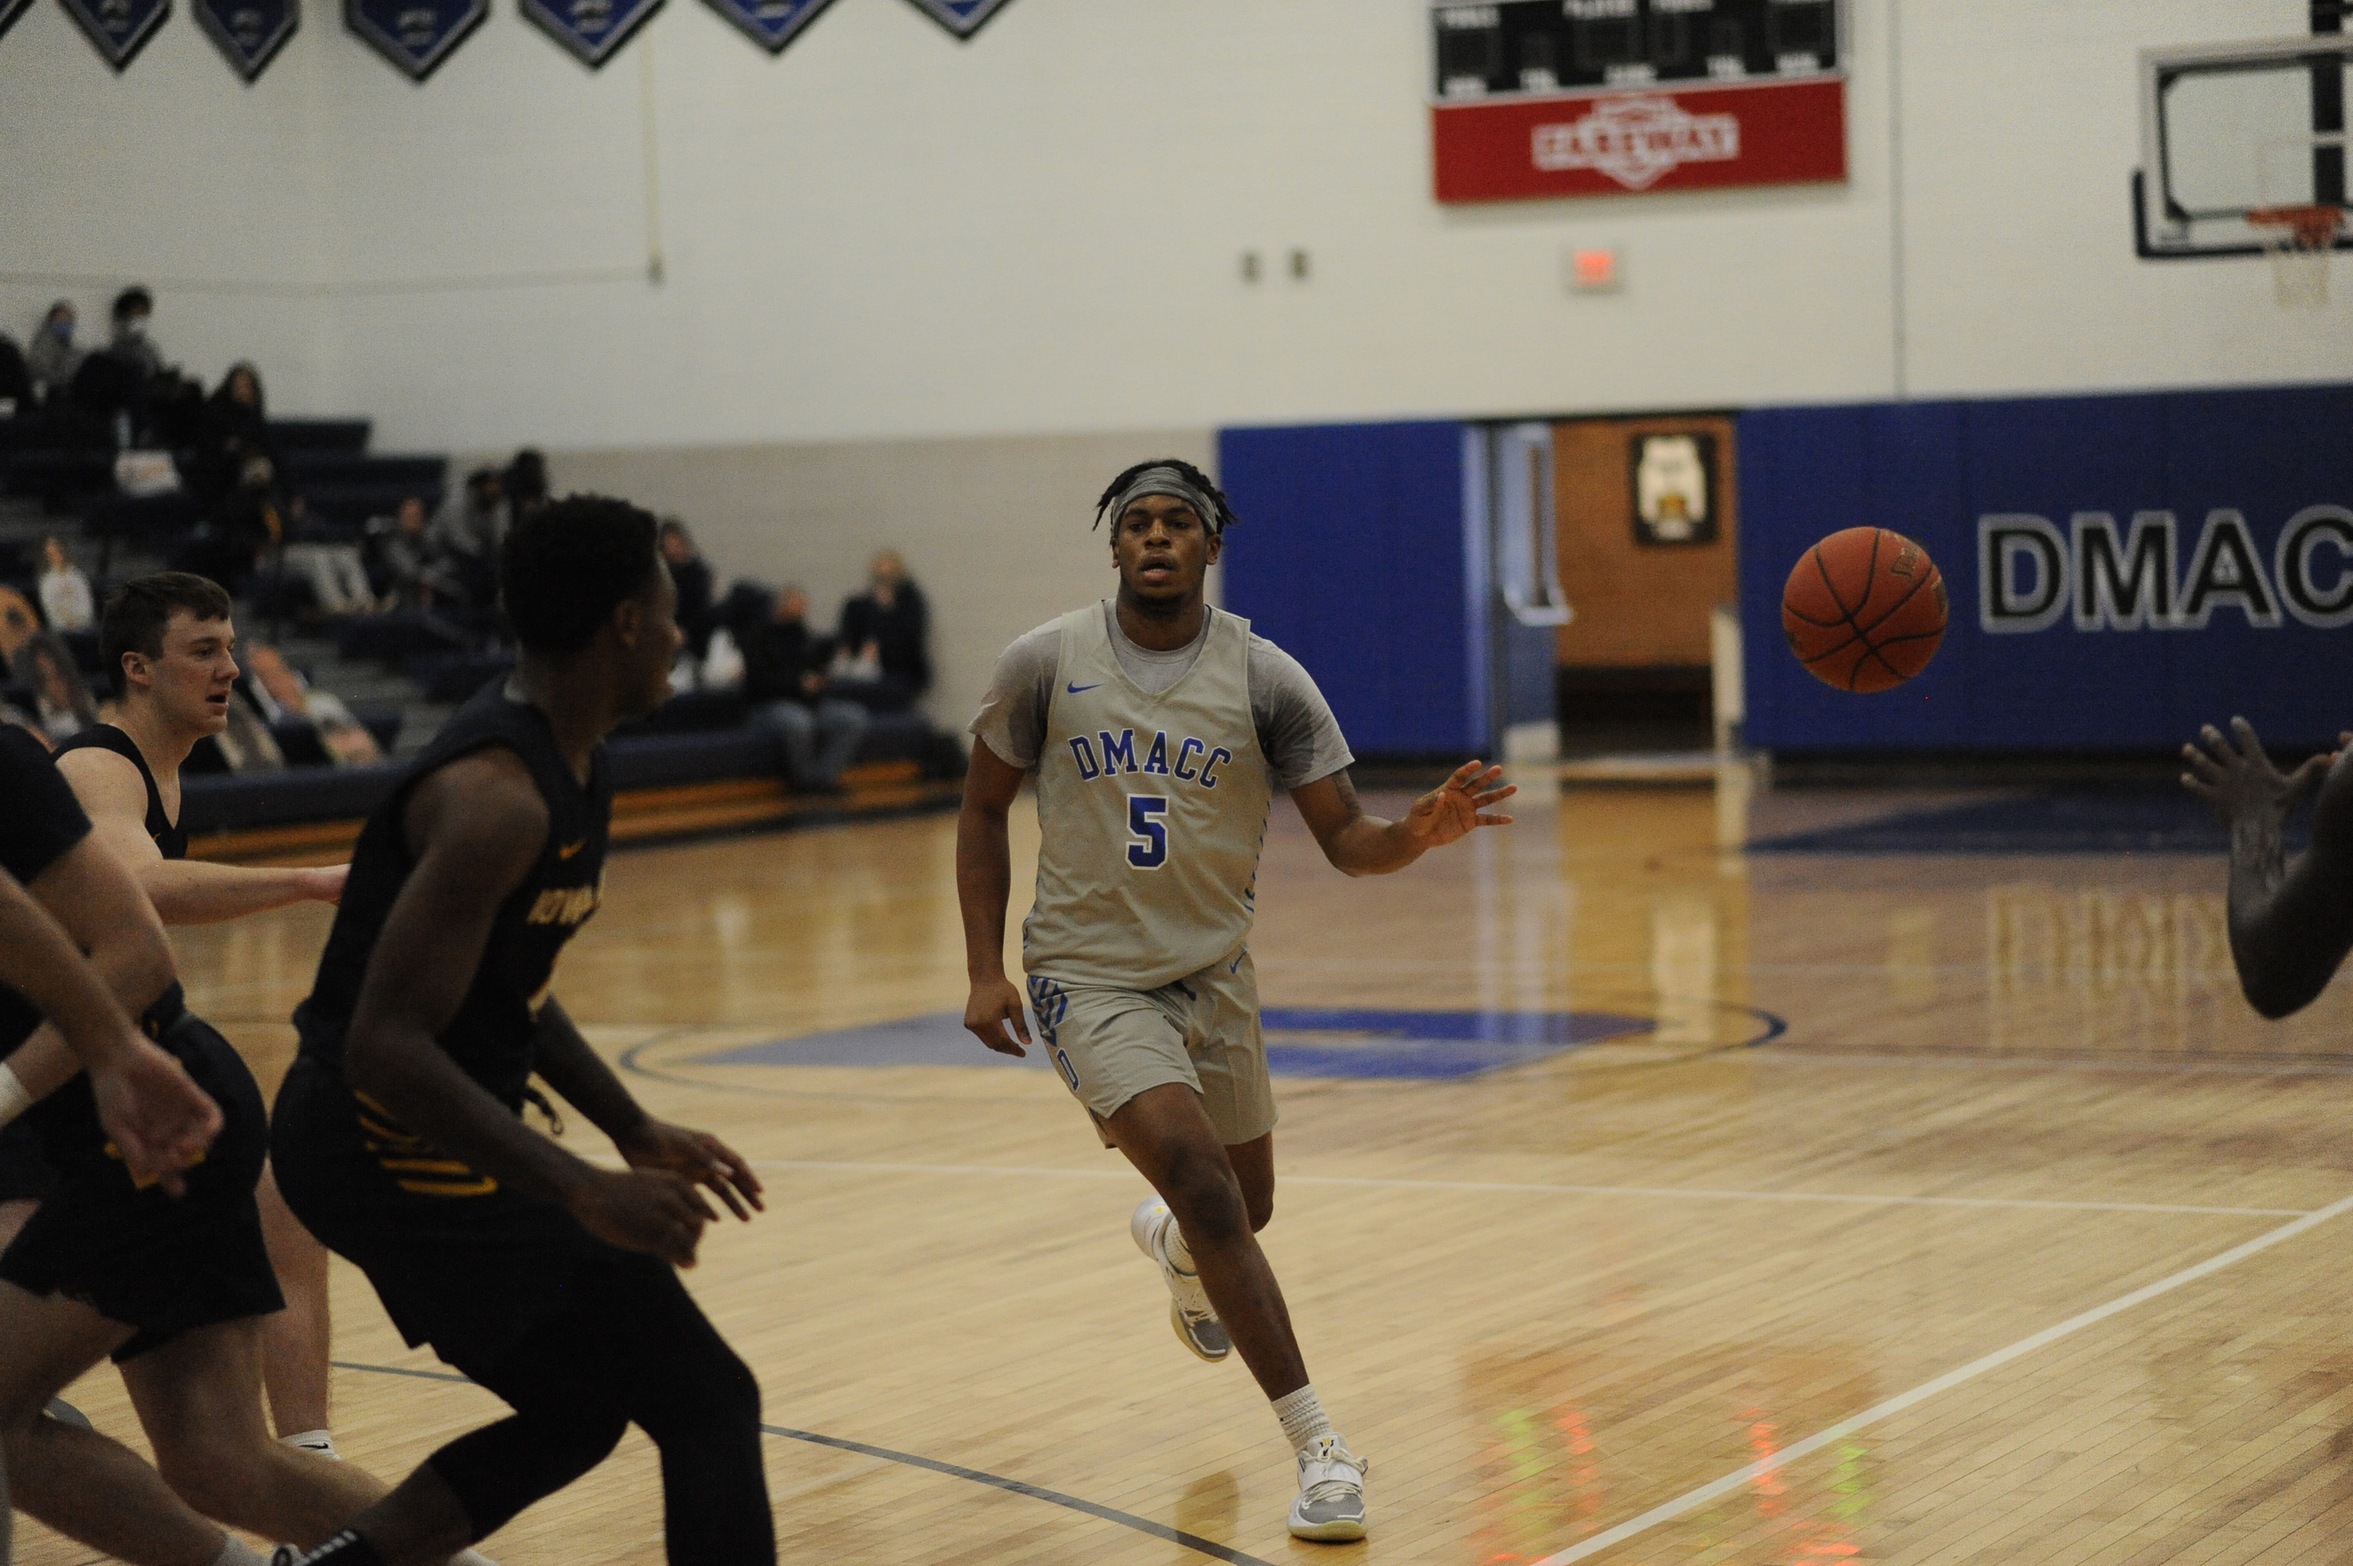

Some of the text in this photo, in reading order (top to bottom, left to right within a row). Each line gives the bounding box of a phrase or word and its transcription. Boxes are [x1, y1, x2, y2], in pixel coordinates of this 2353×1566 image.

[1978, 504, 2353, 633] DMAC
[1068, 728, 1232, 789] DMACC
[1125, 793, 1169, 870] 5
